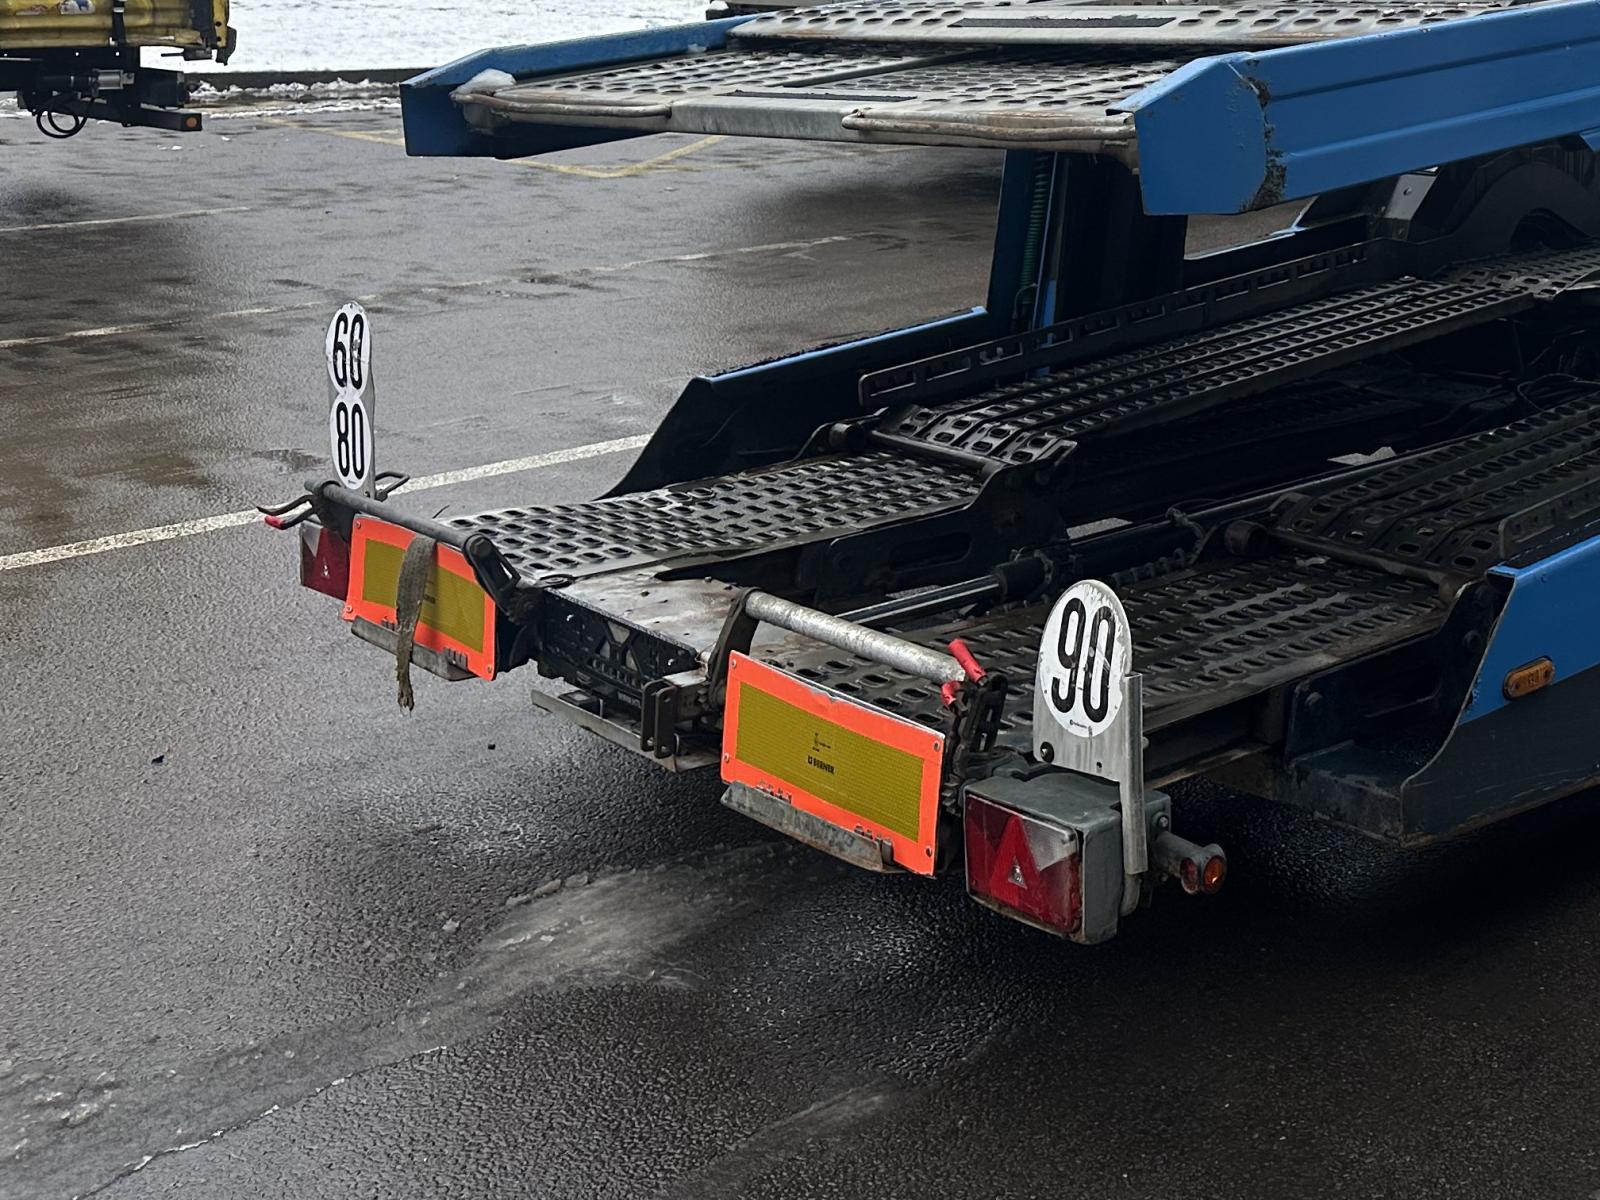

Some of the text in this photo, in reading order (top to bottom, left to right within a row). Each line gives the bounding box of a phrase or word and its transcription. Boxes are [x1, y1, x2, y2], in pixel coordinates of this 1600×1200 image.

[333, 312, 364, 390] 60
[336, 401, 364, 480] 80
[1051, 597, 1116, 723] 90
